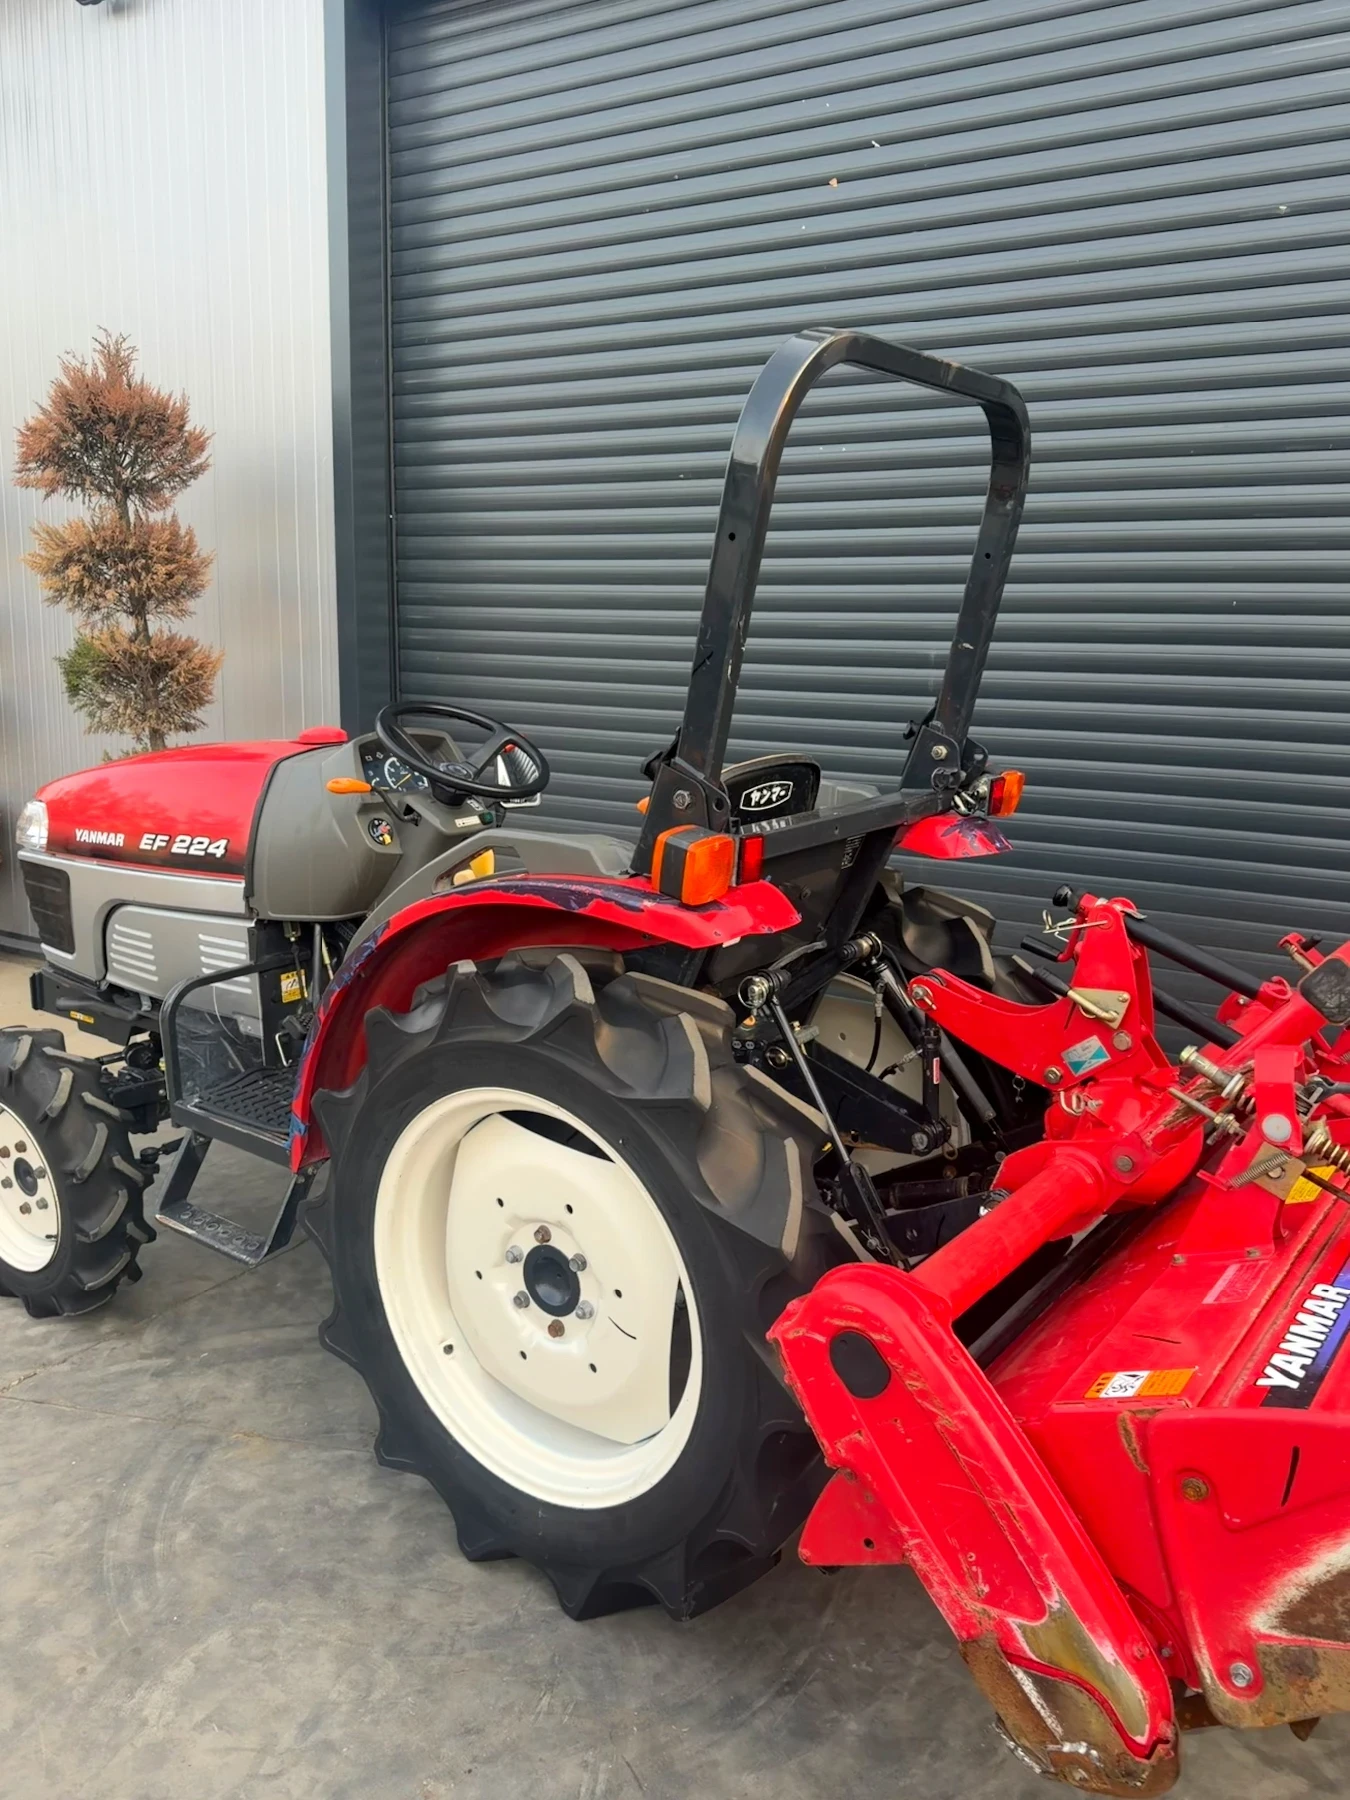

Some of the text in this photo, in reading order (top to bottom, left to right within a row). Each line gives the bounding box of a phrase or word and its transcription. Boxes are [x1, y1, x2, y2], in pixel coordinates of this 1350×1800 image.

[75, 828, 229, 858] YANMAR EF 224
[1255, 1283, 1350, 1389] YANMAR
